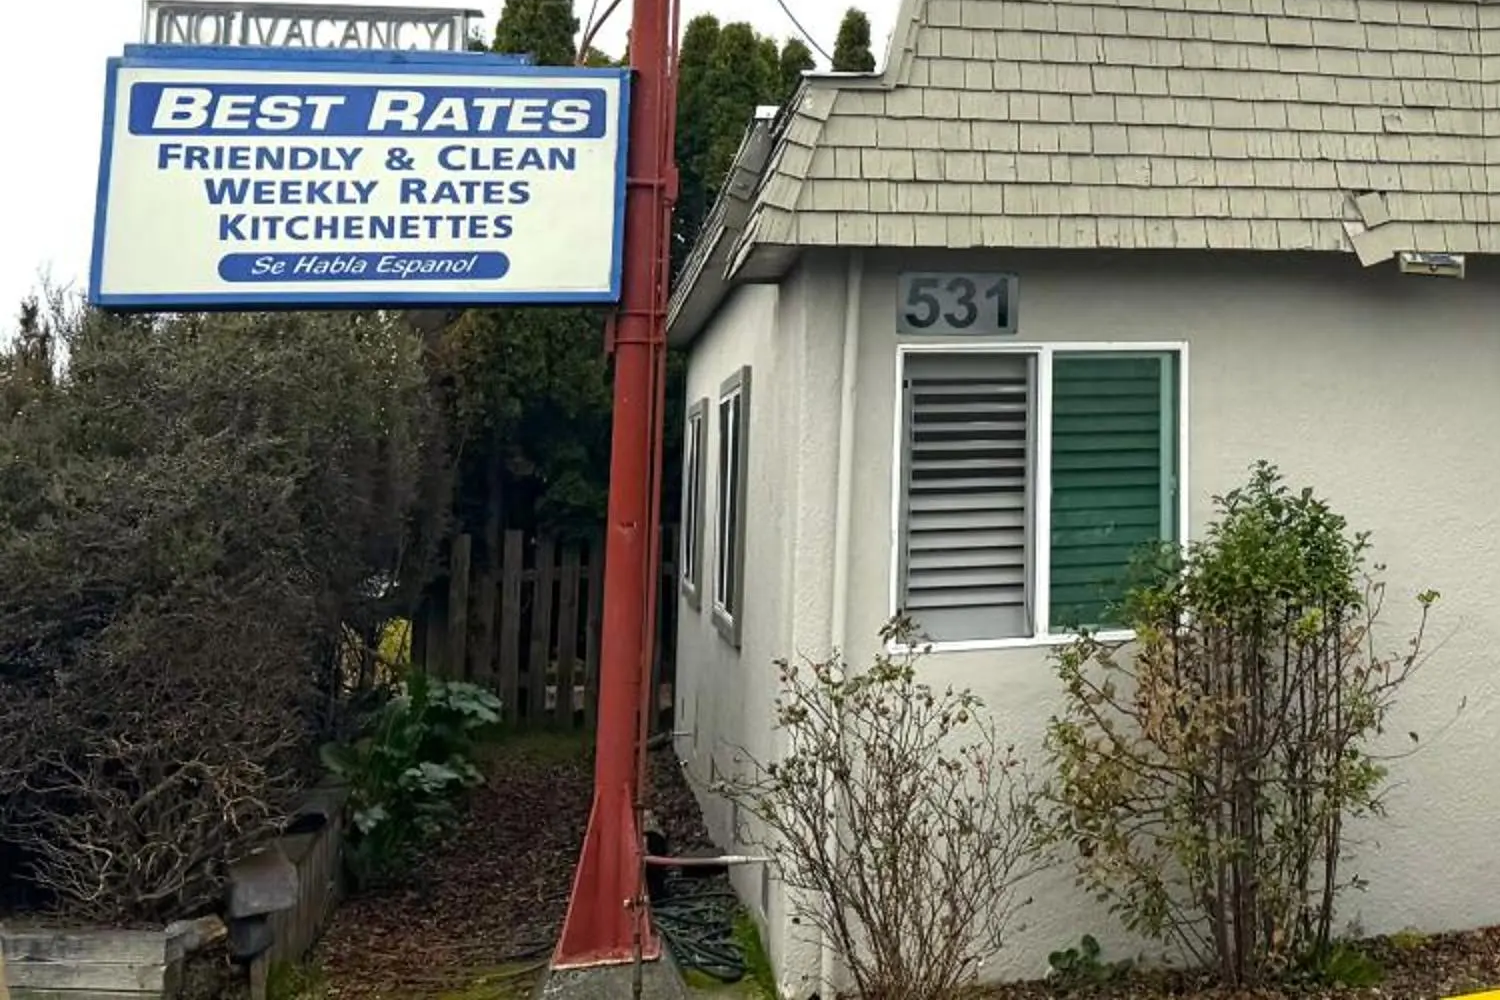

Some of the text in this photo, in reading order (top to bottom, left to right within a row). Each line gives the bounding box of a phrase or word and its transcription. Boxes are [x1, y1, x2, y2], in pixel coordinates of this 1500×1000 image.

[252, 13, 452, 50] VACANCY
[151, 87, 592, 133] BEST RATES
[157, 143, 576, 171] FRIENDLY & CLEAN
[204, 178, 530, 205] WEEKLY RATES
[218, 213, 514, 241] KITCHENETTES
[251, 254, 479, 279] Se Habla Espanol
[905, 277, 1009, 329] 531
